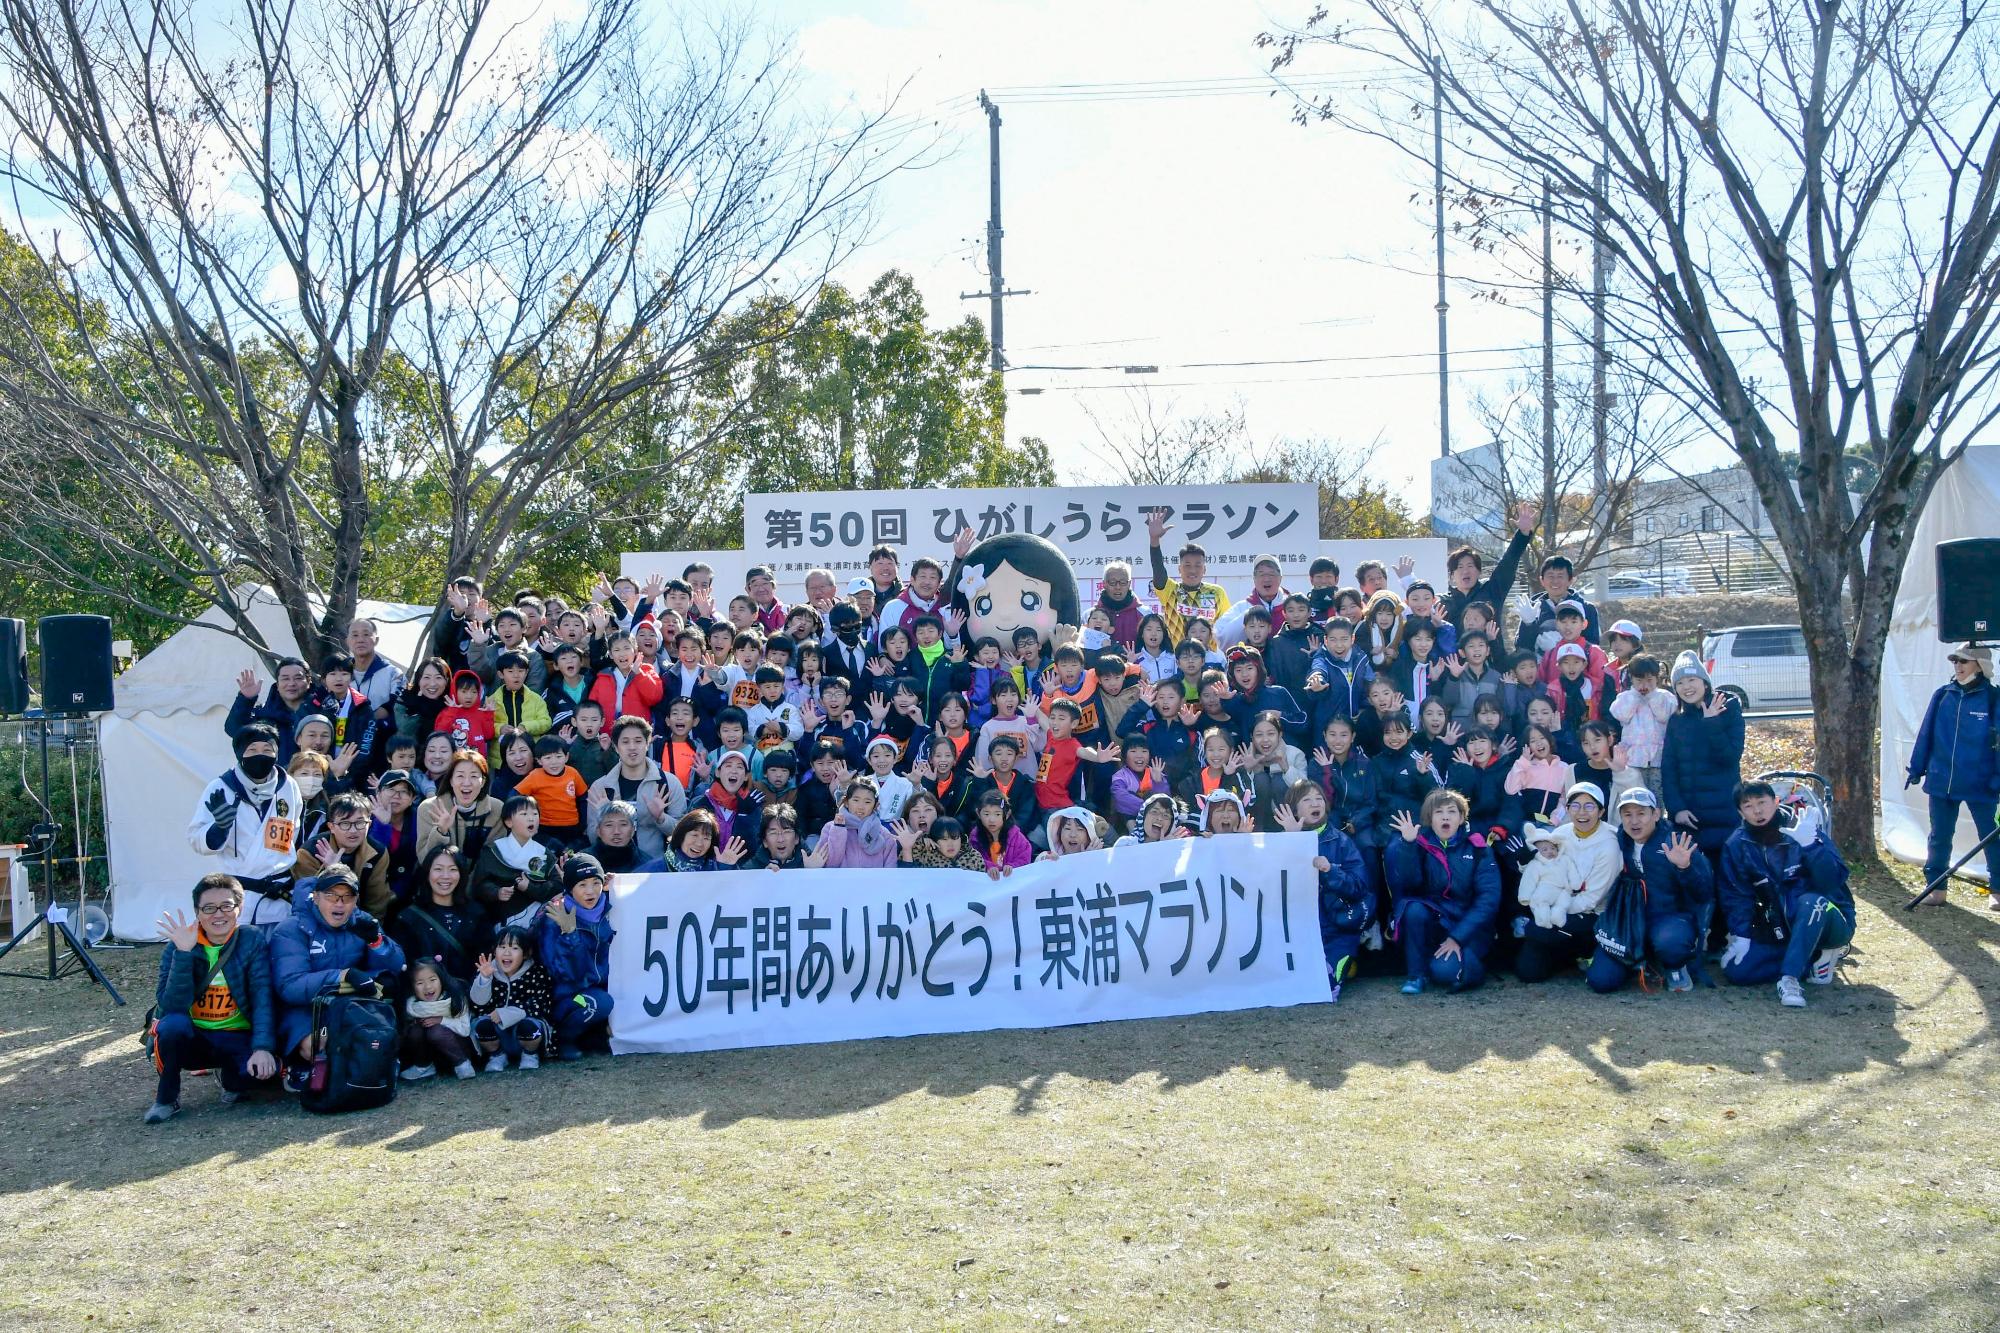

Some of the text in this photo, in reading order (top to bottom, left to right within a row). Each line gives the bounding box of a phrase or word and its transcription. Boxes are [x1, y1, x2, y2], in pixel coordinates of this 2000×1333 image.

[763, 508, 908, 549] 第50回
[735, 686, 759, 700] 9328
[197, 993, 233, 1009] 8172
